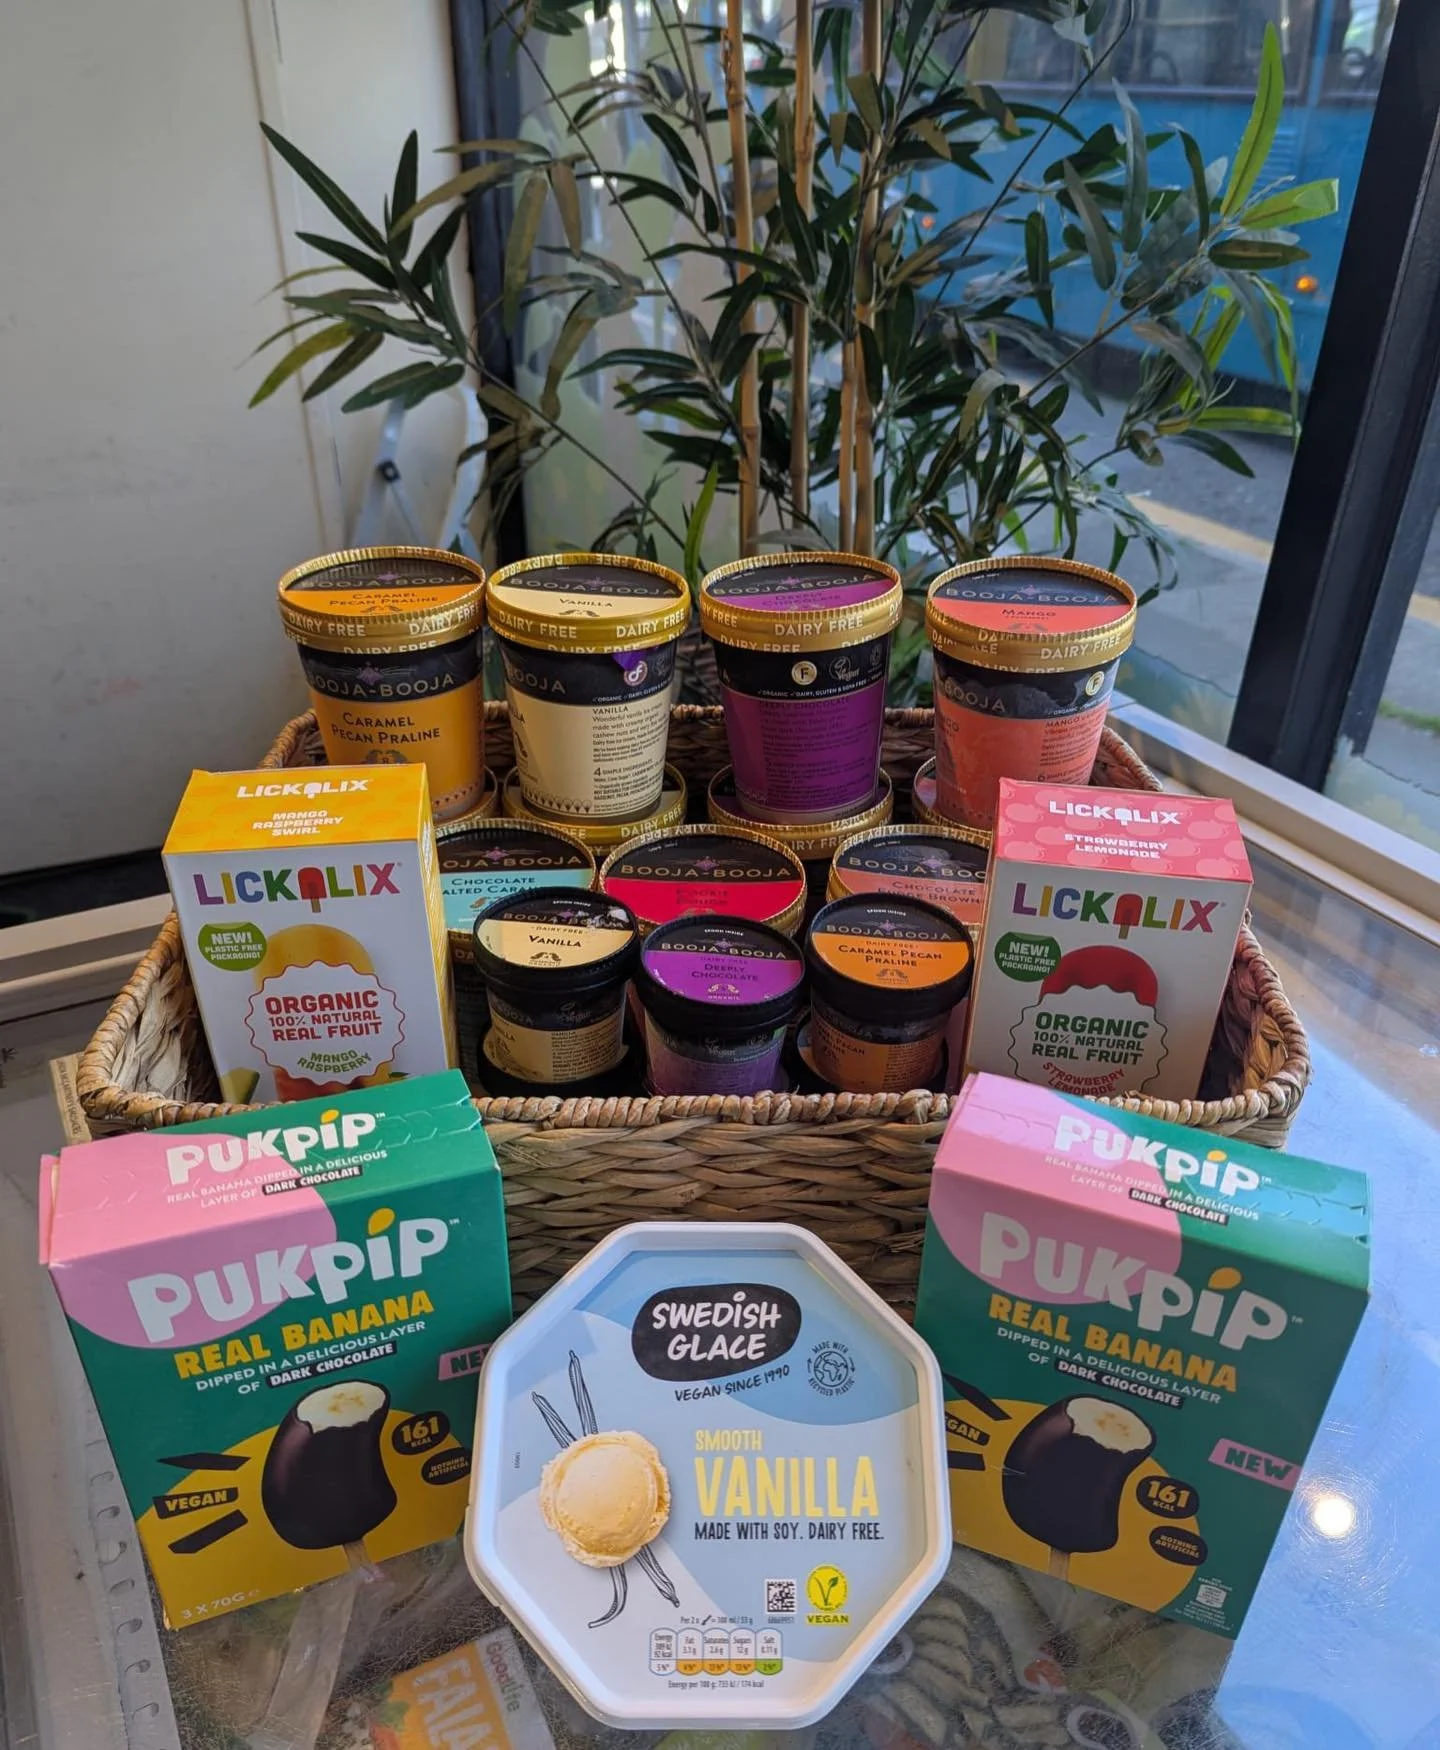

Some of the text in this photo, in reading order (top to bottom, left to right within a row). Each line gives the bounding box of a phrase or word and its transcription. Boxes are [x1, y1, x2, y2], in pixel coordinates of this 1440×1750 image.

[302, 574, 474, 588] BOOJA-BOOJA
[510, 578, 677, 595] BOOJA-BOOJA
[713, 575, 875, 595] BOOJA-BOOJA
[559, 598, 613, 608] VANILLA
[946, 588, 1117, 603] BOOJA-BOOJA
[712, 612, 738, 628] FREE
[1002, 608, 1057, 617] MANGO
[288, 612, 366, 637] DAIRY FREE
[408, 614, 452, 636] DAIRY
[498, 611, 577, 639] DAIRY FREE
[616, 608, 685, 638] DAIRY FREE
[775, 615, 864, 637] DAIRY FREE
[1040, 633, 1121, 660] DAIRY FREE
[342, 712, 415, 728] CARAMEL
[593, 706, 628, 715] VANILLA
[331, 724, 441, 744] PECAN PRALINE
[593, 767, 601, 776] 4
[252, 817, 344, 830] RASPBERRY
[272, 810, 328, 820] MANGO
[621, 819, 658, 838] DAIRY
[663, 805, 682, 825] FREE
[272, 827, 320, 836] SWIRL
[1064, 834, 1168, 850] STRAWBERRY
[1075, 844, 1160, 859] LEMONADE
[443, 856, 582, 869] OJA-BOOJA
[621, 865, 791, 878] BOOJA-BOOJA
[850, 857, 986, 879] BOOJA-BOO
[451, 878, 536, 886] CHOCOLATE
[892, 881, 977, 895] CHOCOLATE
[211, 932, 252, 945] NEW!
[528, 935, 582, 948] VANILLA
[826, 925, 951, 940] BOOJA-BOOJA
[205, 944, 263, 953] PLASTIC FREE
[661, 943, 787, 960] BOOJA-BOOJA
[838, 945, 942, 959] CARAMEL PECAN
[1009, 942, 1050, 957] NEW!
[704, 964, 746, 972] DEEPLY
[866, 956, 917, 966] PRALINE
[999, 953, 1055, 966] PLASTIC FREE
[692, 971, 758, 982] CHOCOLATE
[265, 990, 378, 1015] ORGANIC
[268, 1010, 381, 1027] 100% NATURAL
[1036, 1012, 1149, 1039] ORGANIC
[273, 1022, 382, 1042] REAL FRUIT
[1034, 1031, 1144, 1050] 100% NATURAL
[297, 1052, 372, 1074] RASPBERRY
[310, 1050, 358, 1063] MANGO
[1031, 1043, 1143, 1066] REAL FRUIT
[1043, 1062, 1126, 1086] STRAWBERRY
[167, 1150, 388, 1204] REAL BANANA DIPPED IN A DELICIOUS
[200, 1166, 360, 1208] LAYER OF DARK CHOCOLATE
[1045, 1156, 1073, 1170] REAL
[1074, 1162, 1122, 1182] BANANA
[1125, 1176, 1166, 1194] DIPPED
[1169, 1189, 1182, 1198] IN
[1196, 1196, 1260, 1220] DELICIOUS
[1071, 1174, 1228, 1224] LAYER OF DARK CHOCOLATE
[652, 1291, 782, 1330] SWEDISH
[174, 1290, 434, 1380] REAL BANANA
[989, 1294, 1237, 1393] REAL BANANA
[196, 1321, 426, 1392] DIPPED IN A DELICIOUS LAYER
[667, 1334, 767, 1362] GLACE
[238, 1344, 394, 1394] OF DARK CHOCOLATE
[997, 1326, 1222, 1405] DIPPED IN A DELICIOUS LAYER
[675, 1364, 790, 1402] VEGAN SINCE 1990
[1028, 1351, 1181, 1406] OF DARK CHOCOLATE
[401, 1416, 440, 1444] 161
[948, 1420, 980, 1440] GAN
[410, 1437, 432, 1448] KCAL
[694, 1429, 762, 1451] SMOOTH
[1224, 1447, 1294, 1481] NEW
[694, 1456, 879, 1518] VANILLA
[1148, 1480, 1190, 1508] 161
[164, 1489, 228, 1512] VEGAN
[1152, 1500, 1176, 1512] KCAL
[694, 1522, 884, 1540] MADE WITH SOY. DAIRY FREE.
[1155, 1539, 1200, 1558] ARTIFICIAL
[1160, 1534, 1198, 1551] NOTHING
[182, 1592, 246, 1620] 3 70G
[806, 1615, 849, 1624] VEGAN
[668, 1680, 688, 1690] Energy
